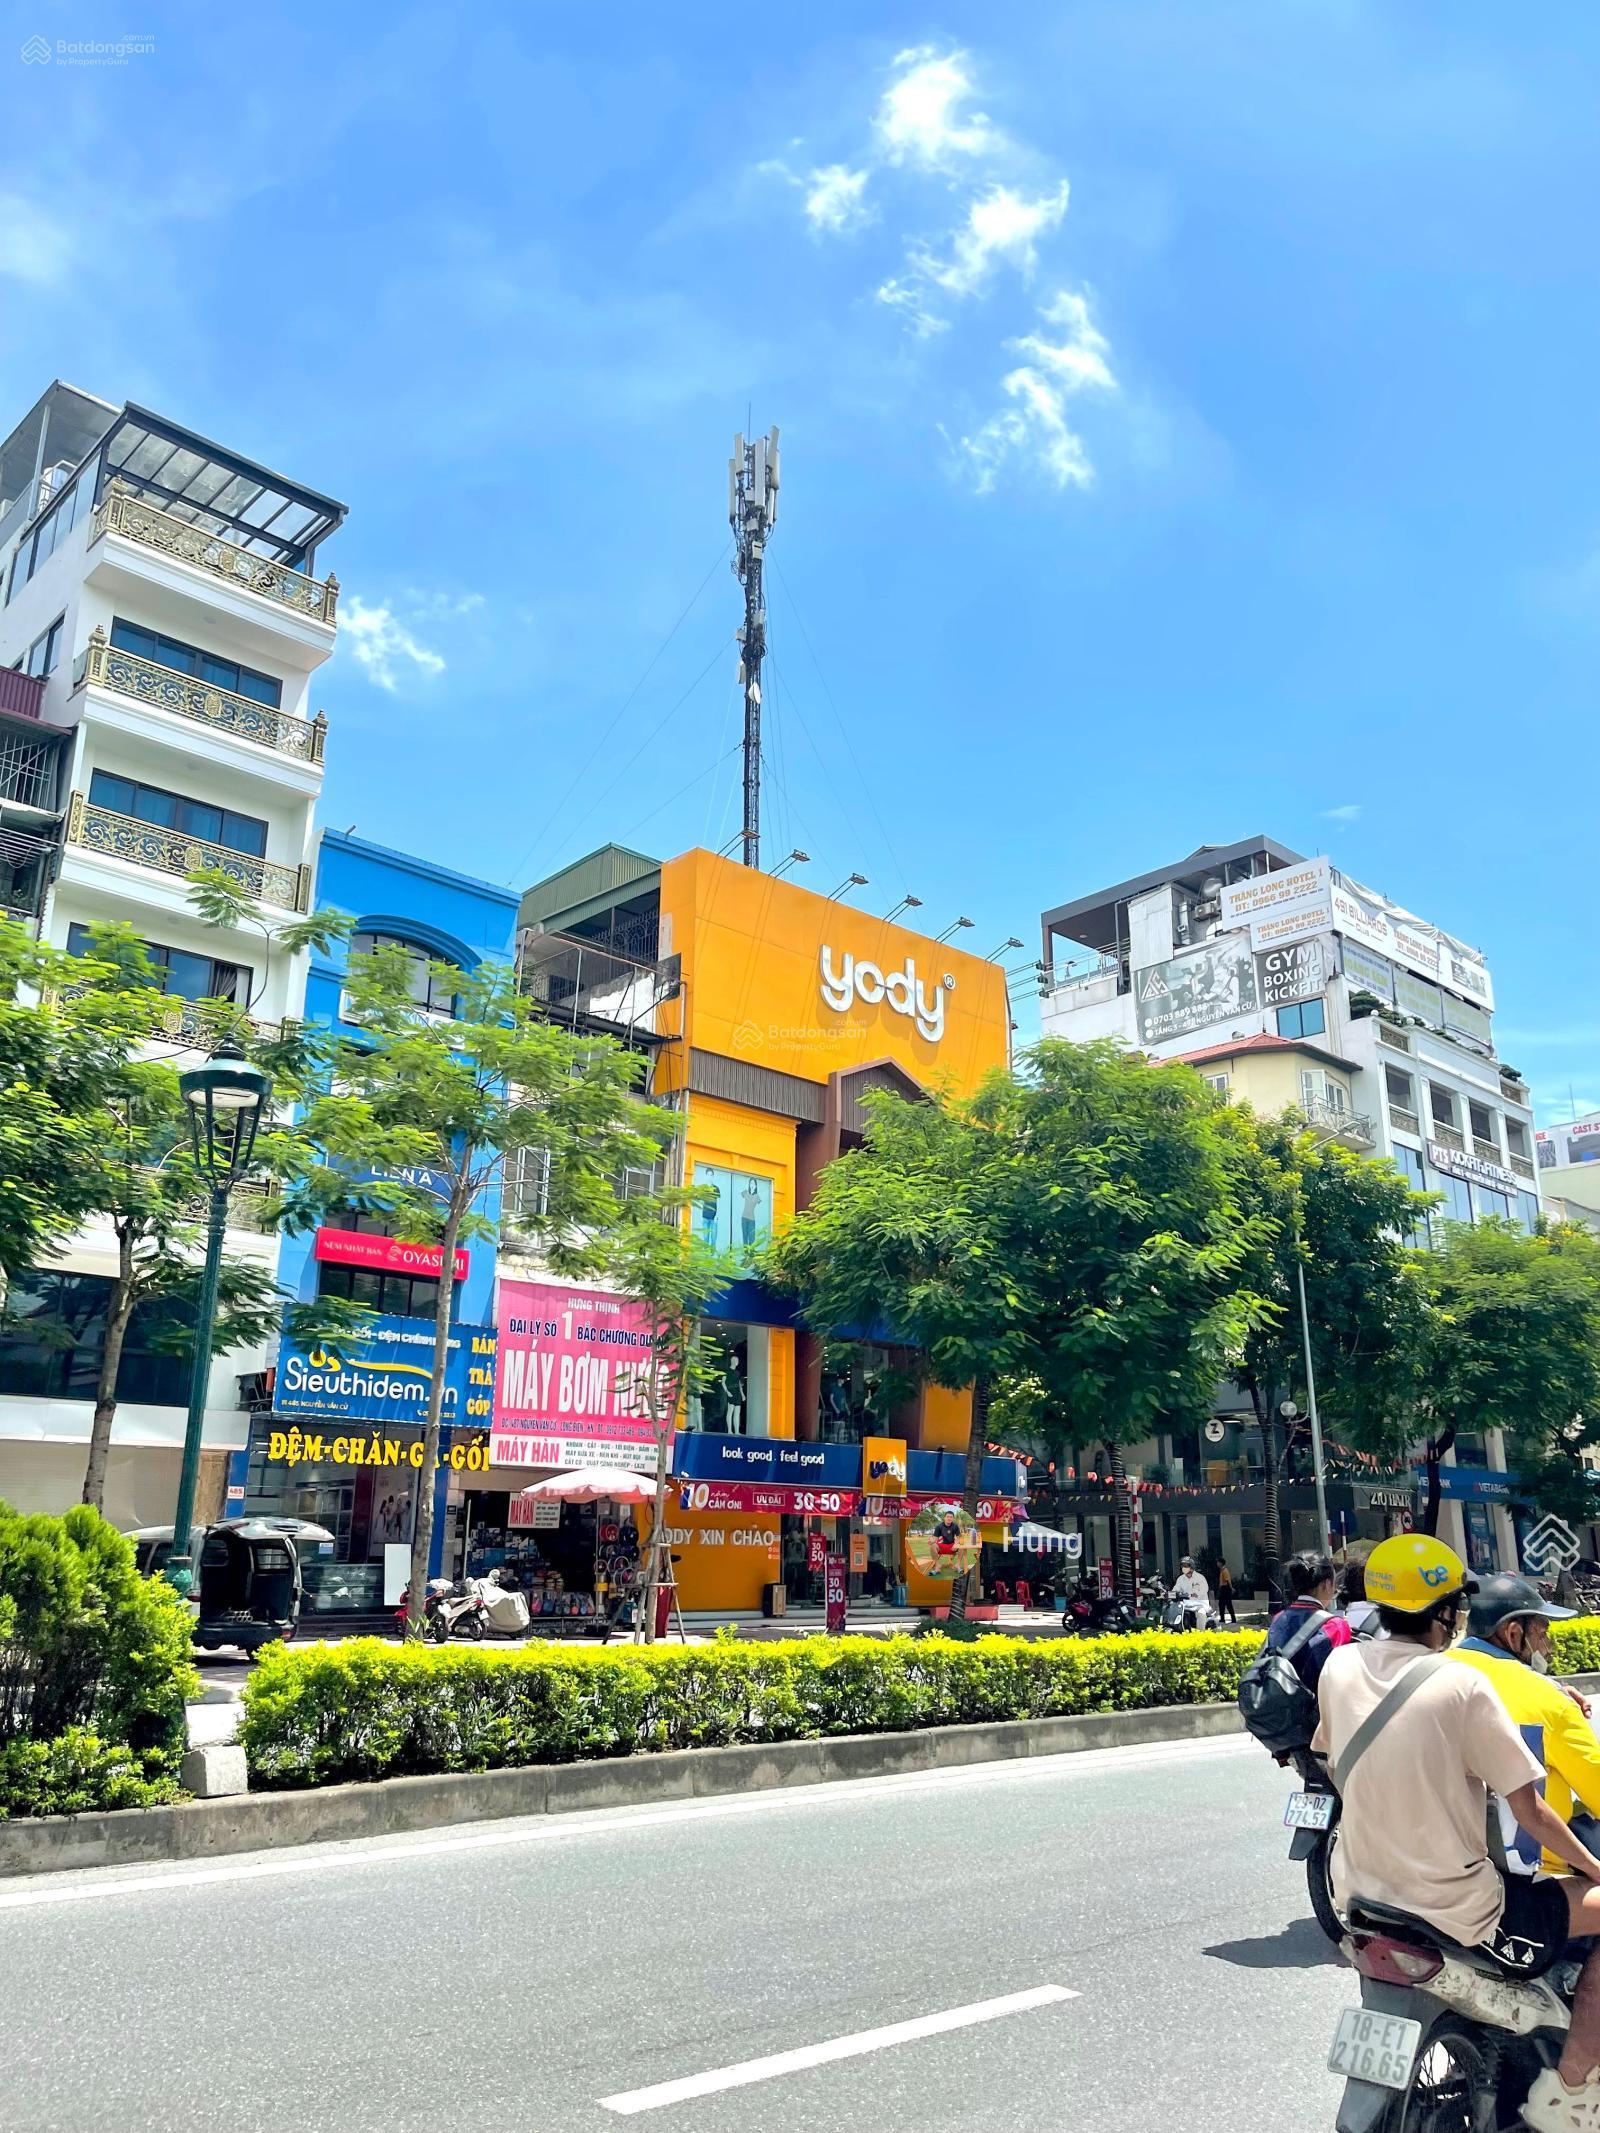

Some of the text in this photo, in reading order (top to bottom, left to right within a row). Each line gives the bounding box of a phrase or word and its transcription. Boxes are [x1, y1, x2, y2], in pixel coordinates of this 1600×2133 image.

[1260, 880, 1285, 894] LONG
[1286, 870, 1317, 887] HOTEL
[1348, 904, 1388, 937] BILLIARDS
[1265, 940, 1322, 972] GYM
[1263, 963, 1322, 989] BOXING
[819, 944, 945, 1043] yody
[1264, 980, 1322, 1003] KICKFIT
[1153, 1012, 1174, 1025] 0703
[1572, 1124, 1592, 1135] CAST
[1432, 1143, 1449, 1164] PTS
[594, 1301, 620, 1315] THỊNH
[509, 1318, 527, 1338] ĐẠI
[529, 1318, 542, 1336] LÝ
[543, 1317, 558, 1337] SỐ
[561, 1311, 574, 1340] 1
[577, 1320, 596, 1341] BẮC
[599, 1329, 637, 1346] CHƯƠNG
[471, 1334, 496, 1355] BÁN
[469, 1362, 493, 1386] TRẢ
[501, 1338, 555, 1411] MÁY
[558, 1350, 609, 1416] BƠM
[466, 1393, 491, 1416] GÓP
[496, 1437, 561, 1464] MÁY HÀN
[722, 1446, 825, 1467] look good feel good
[865, 1456, 907, 1482] yody
[687, 1483, 710, 1509] 10
[708, 1500, 726, 1510] CẢM
[700, 1529, 725, 1546] XIN
[812, 1542, 821, 1551] 30
[811, 1551, 824, 1562] 50
[828, 1577, 840, 1587] 30
[1417, 1565, 1449, 1588] be
[828, 1589, 844, 1603] 50
[1101, 1587, 1113, 1599] 50
[1350, 2013, 1408, 2052] 18-E1
[1332, 2040, 1409, 2083] 216.65
